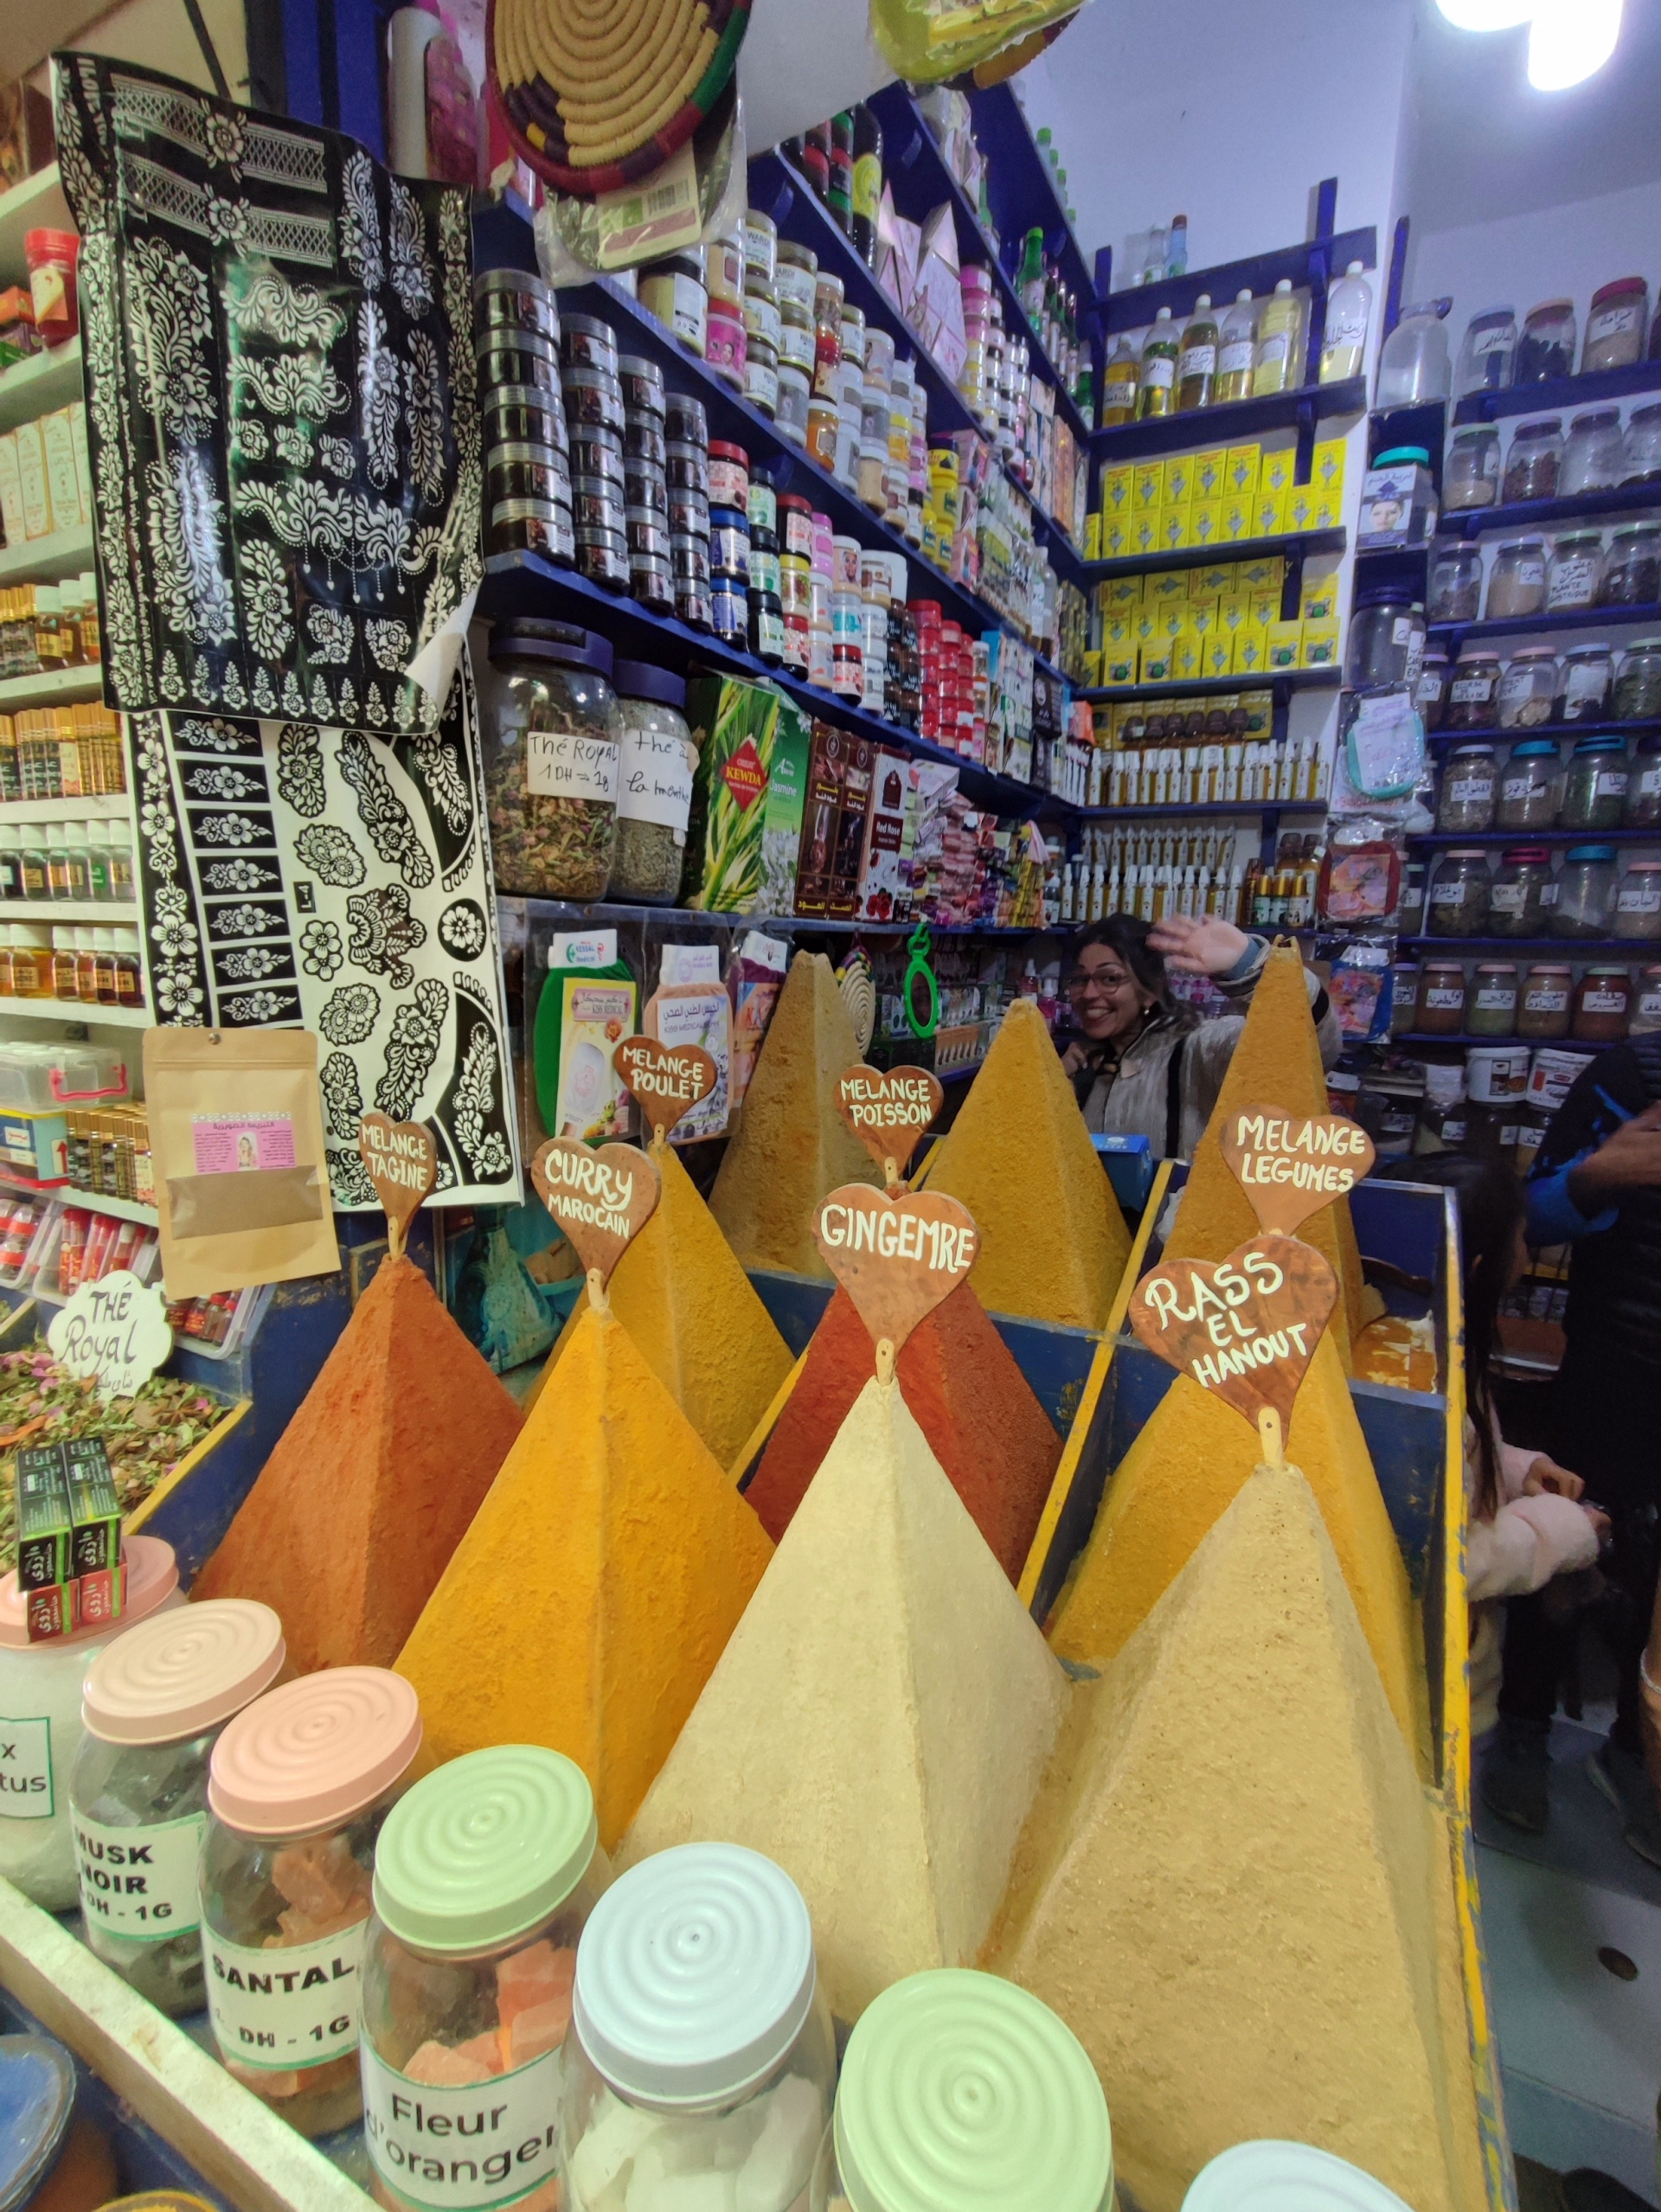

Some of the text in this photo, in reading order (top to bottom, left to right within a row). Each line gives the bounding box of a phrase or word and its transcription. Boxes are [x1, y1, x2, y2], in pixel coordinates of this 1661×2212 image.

[529, 735, 569, 757] Thé
[726, 766, 761, 786] KEWDA
[770, 778, 798, 798] Jasmine
[876, 820, 901, 837] Red Rose
[623, 1046, 704, 1081] MELANGE
[631, 1068, 704, 1100] POULET
[840, 1079, 932, 1102] MELANGE
[849, 1102, 933, 1127] POISSON
[362, 1123, 428, 1161] MELANGE
[1237, 1115, 1366, 1156] MELANGE
[367, 1151, 428, 1191] TAGINE
[545, 1148, 632, 1211] CURRY
[1241, 1153, 1356, 1193] LEGUMES
[548, 1193, 631, 1241] MAROCAIN
[821, 1204, 974, 1273] GINGEMRE
[89, 1280, 133, 1324] THÉ
[1145, 1252, 1284, 1330] RASS
[59, 1314, 138, 1382] Royal
[1207, 1310, 1257, 1347] EL
[1192, 1323, 1307, 1388] HANOUT
[213, 1953, 355, 1995] SANTAL
[239, 2025, 275, 2049] DH
[309, 2014, 350, 2042] 1G
[392, 2093, 508, 2137] Fleur
